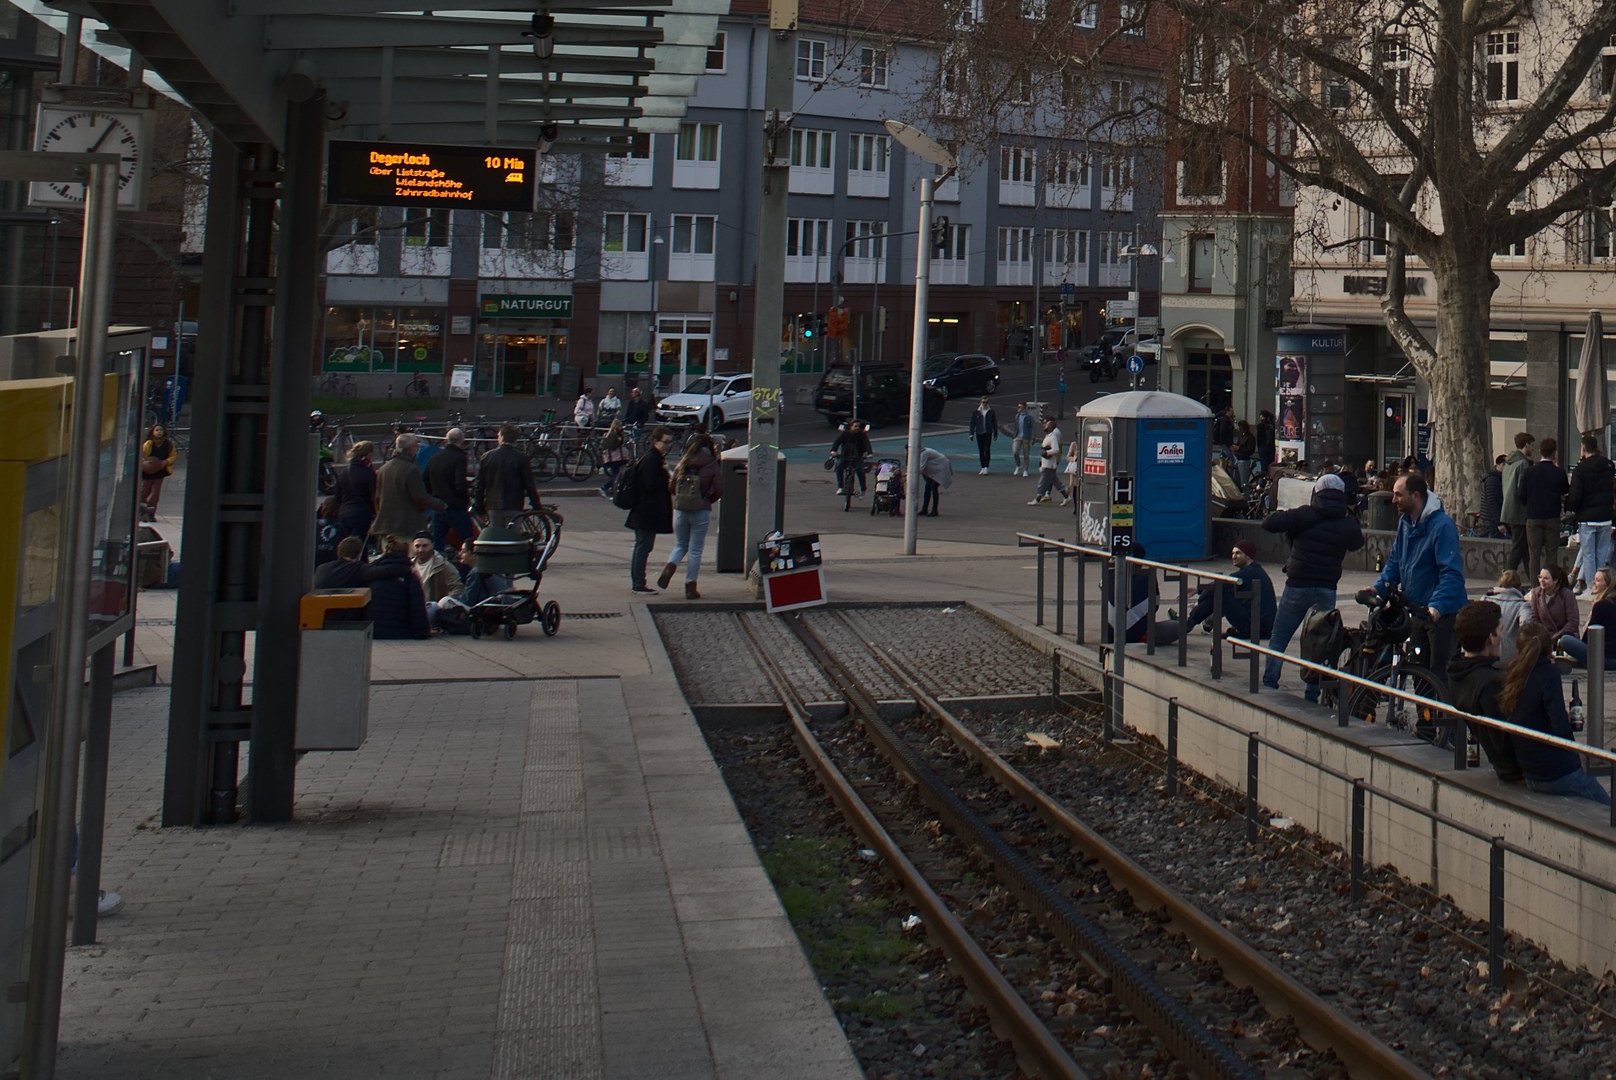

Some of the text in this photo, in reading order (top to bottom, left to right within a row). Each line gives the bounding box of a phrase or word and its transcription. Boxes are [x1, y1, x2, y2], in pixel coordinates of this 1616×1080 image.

[369, 151, 525, 170] Degerloch 10 Min
[396, 168, 445, 179] Liststraße
[395, 178, 463, 188] Wielandshöhe
[395, 187, 474, 200] Zahnradbahnhof
[501, 299, 571, 310] NATURGUT
[1158, 444, 1184, 456] Sanita
[1114, 480, 1132, 502] H
[1113, 535, 1131, 547] FS
